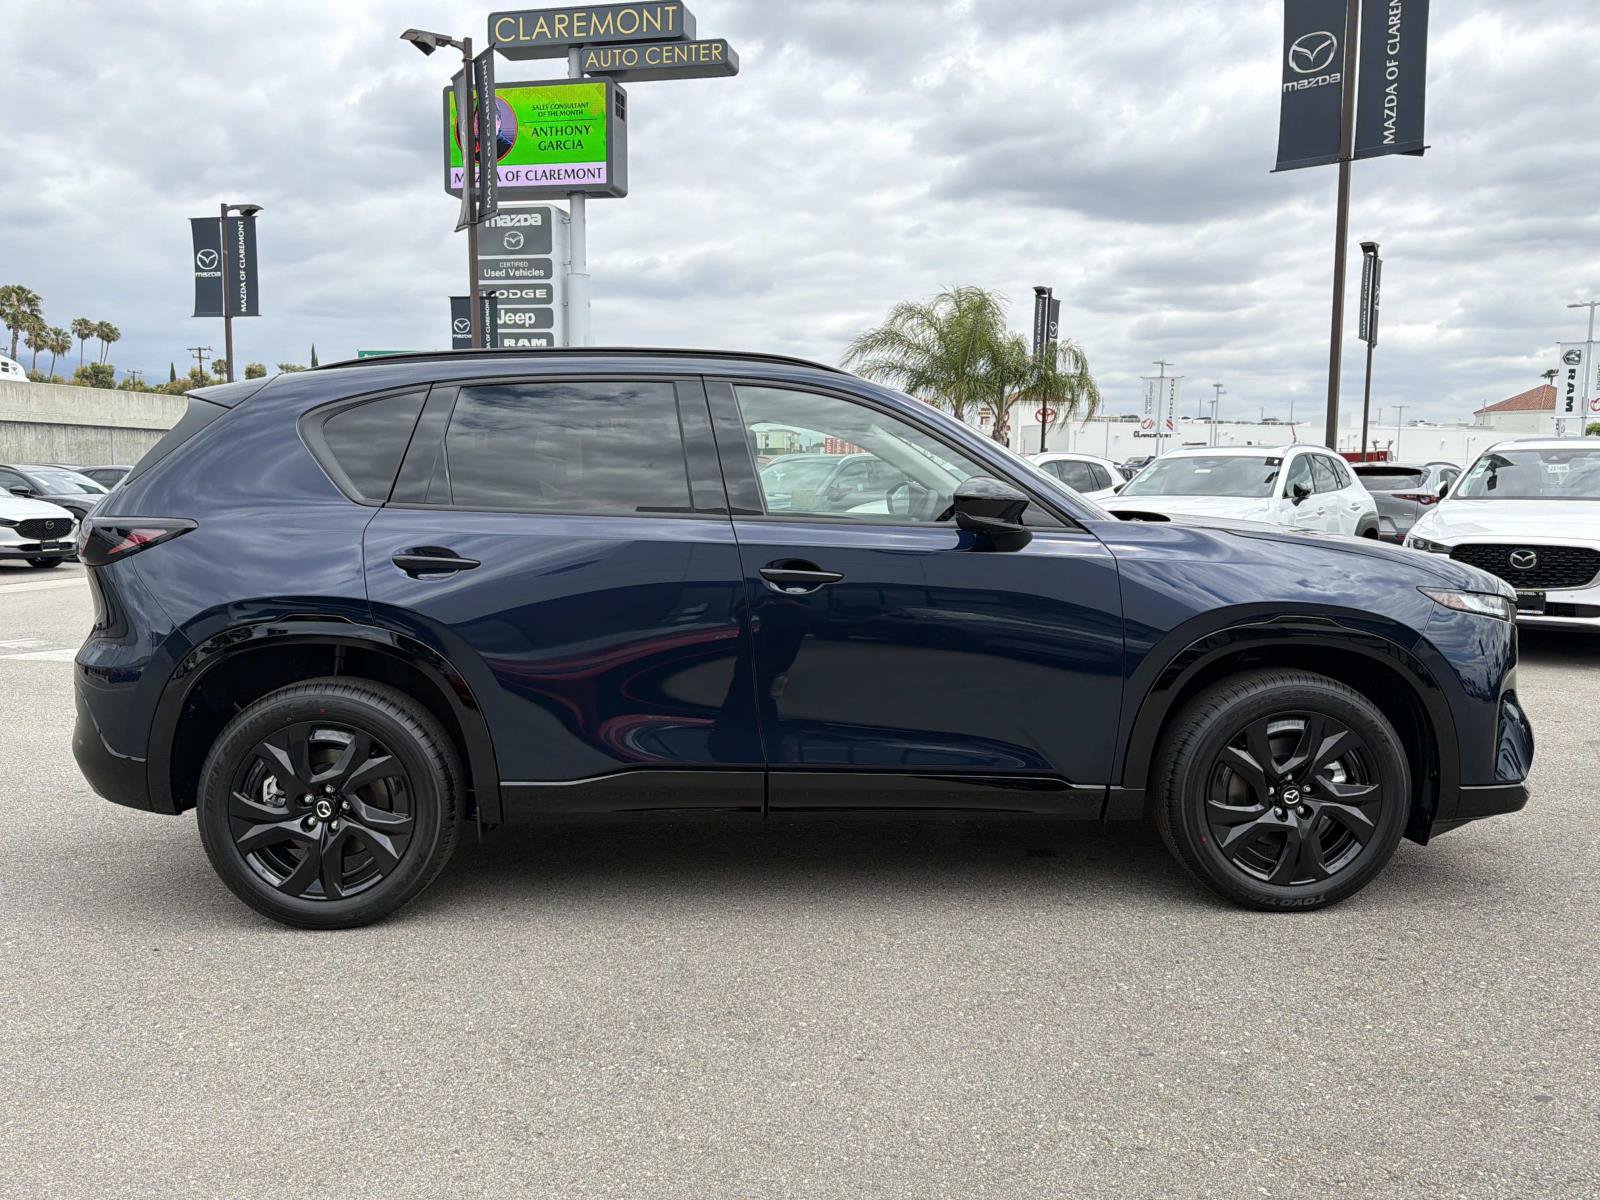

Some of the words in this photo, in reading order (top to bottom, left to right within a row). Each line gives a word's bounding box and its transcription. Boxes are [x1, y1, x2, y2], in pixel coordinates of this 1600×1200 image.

[495, 6, 677, 42] CLAREMONT
[585, 47, 639, 69] AUTO
[645, 43, 722, 65] CENTER
[1385, 59, 1399, 80] OF
[1382, 83, 1398, 145] MAZDA
[531, 125, 591, 137] ANTHONY
[538, 139, 584, 151] GARCIA
[505, 170, 522, 182] OF
[525, 167, 603, 182] CLAREMONT
[237, 220, 245, 269] CLAREMONT
[239, 269, 246, 281] OF
[483, 268, 506, 278] Used
[508, 267, 545, 277] Vehicles
[497, 309, 536, 327] Jeep
[503, 338, 548, 347] RAM
[1565, 368, 1576, 412] RAM
